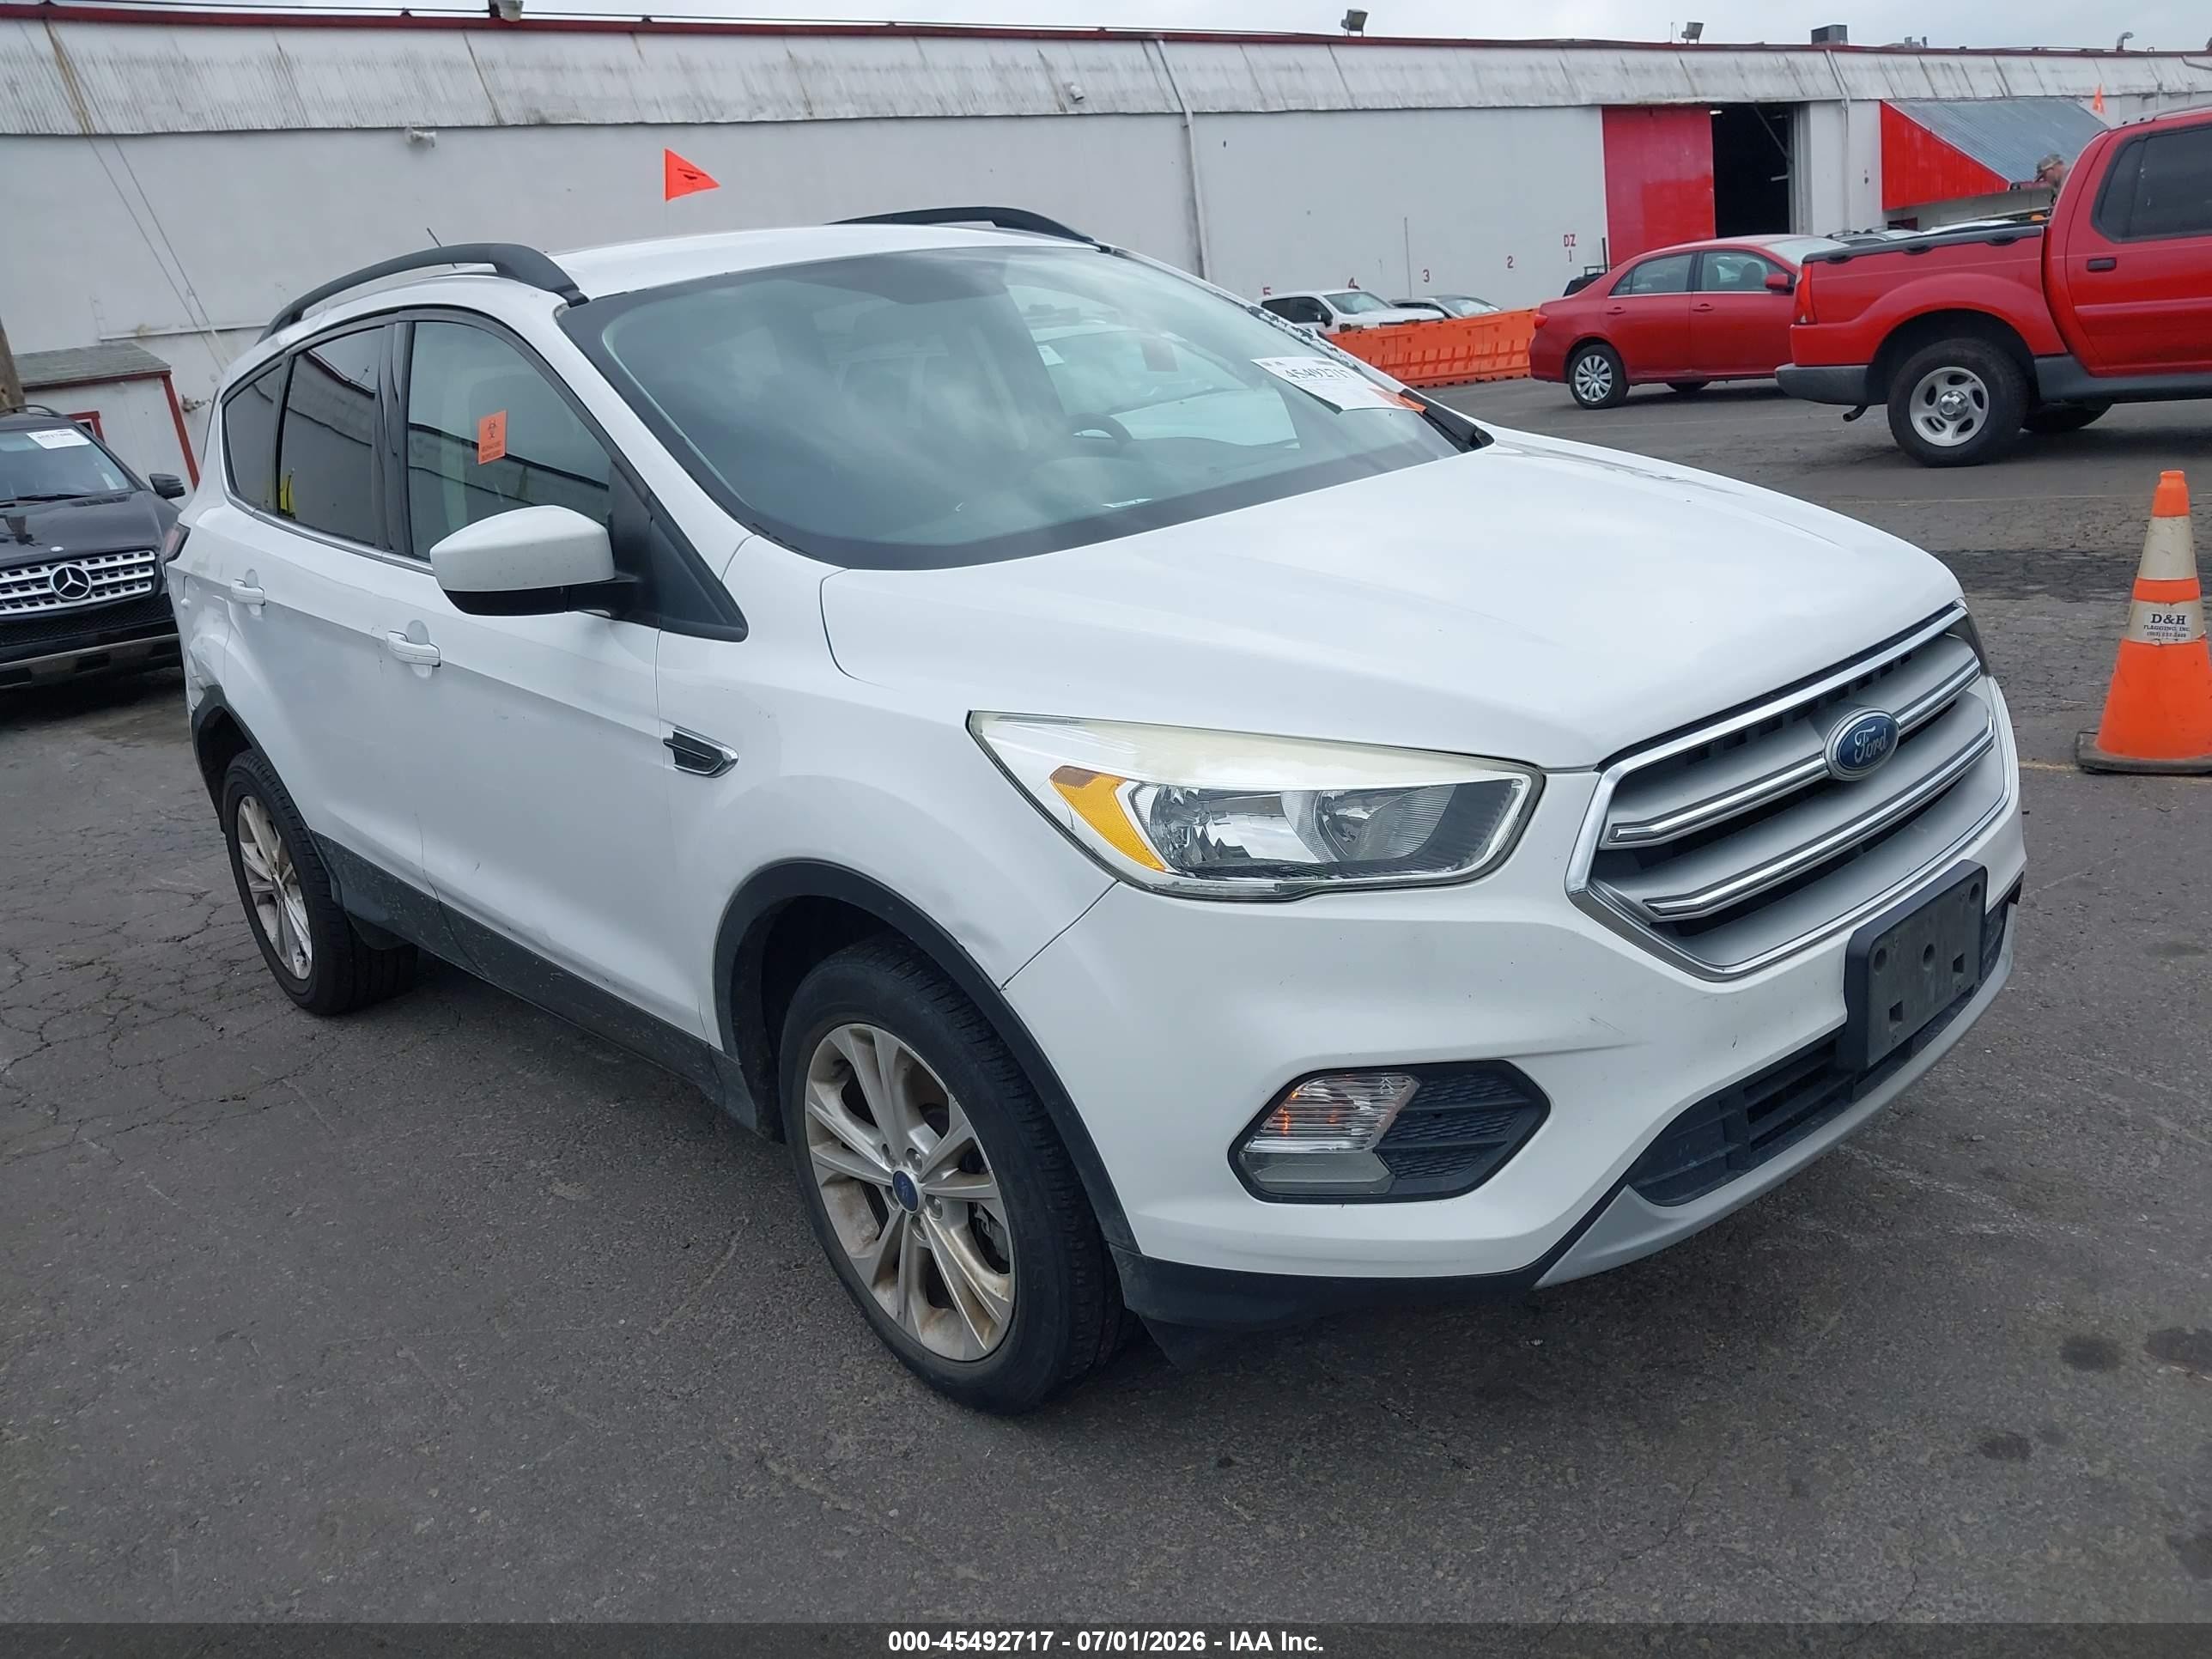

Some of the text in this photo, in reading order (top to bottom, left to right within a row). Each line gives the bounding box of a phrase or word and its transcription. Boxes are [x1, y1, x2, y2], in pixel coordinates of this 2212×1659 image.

[1563, 234, 1577, 247] DZ
[1507, 255, 1514, 269] 2
[1568, 250, 1573, 263] 1
[1423, 269, 1431, 283] 3
[2150, 613, 2186, 625] D&H
[1854, 725, 1889, 763] Ford
